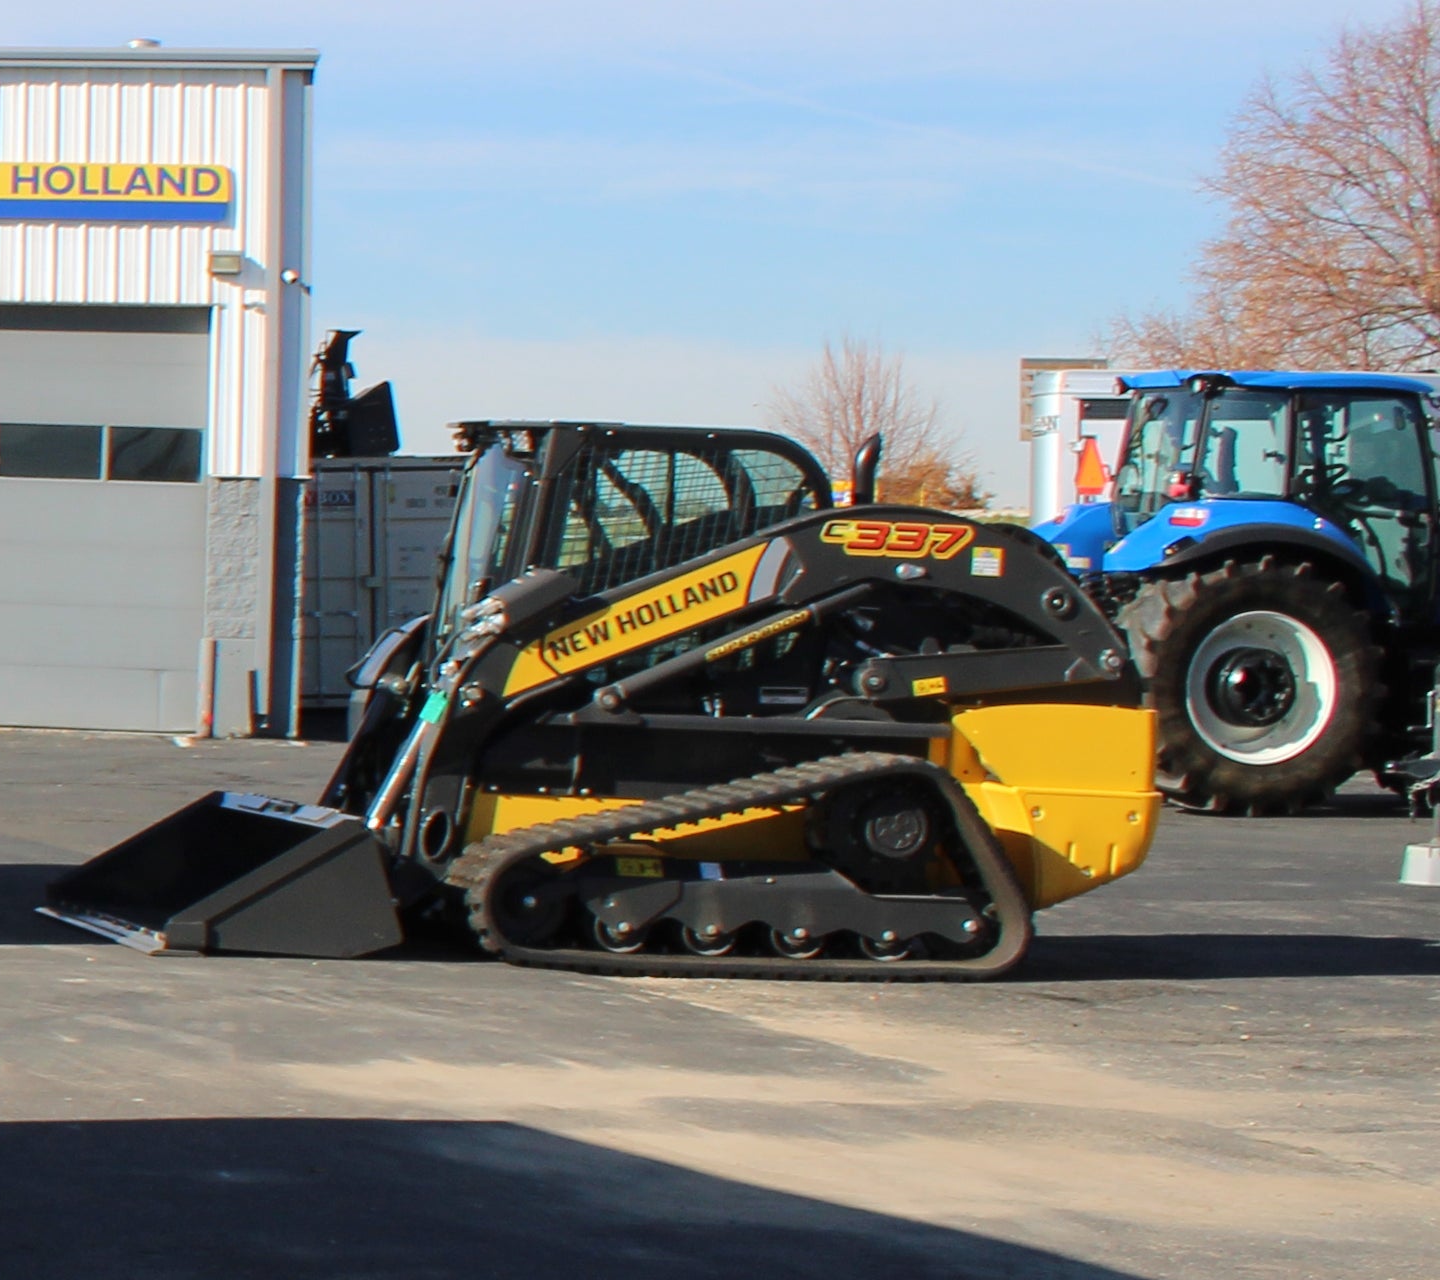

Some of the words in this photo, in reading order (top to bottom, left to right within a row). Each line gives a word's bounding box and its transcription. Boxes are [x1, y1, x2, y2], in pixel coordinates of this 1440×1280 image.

[10, 165, 222, 198] HOLLAND
[821, 520, 976, 558] C337
[547, 620, 611, 661] NEW
[614, 570, 738, 635] HOLLAND
